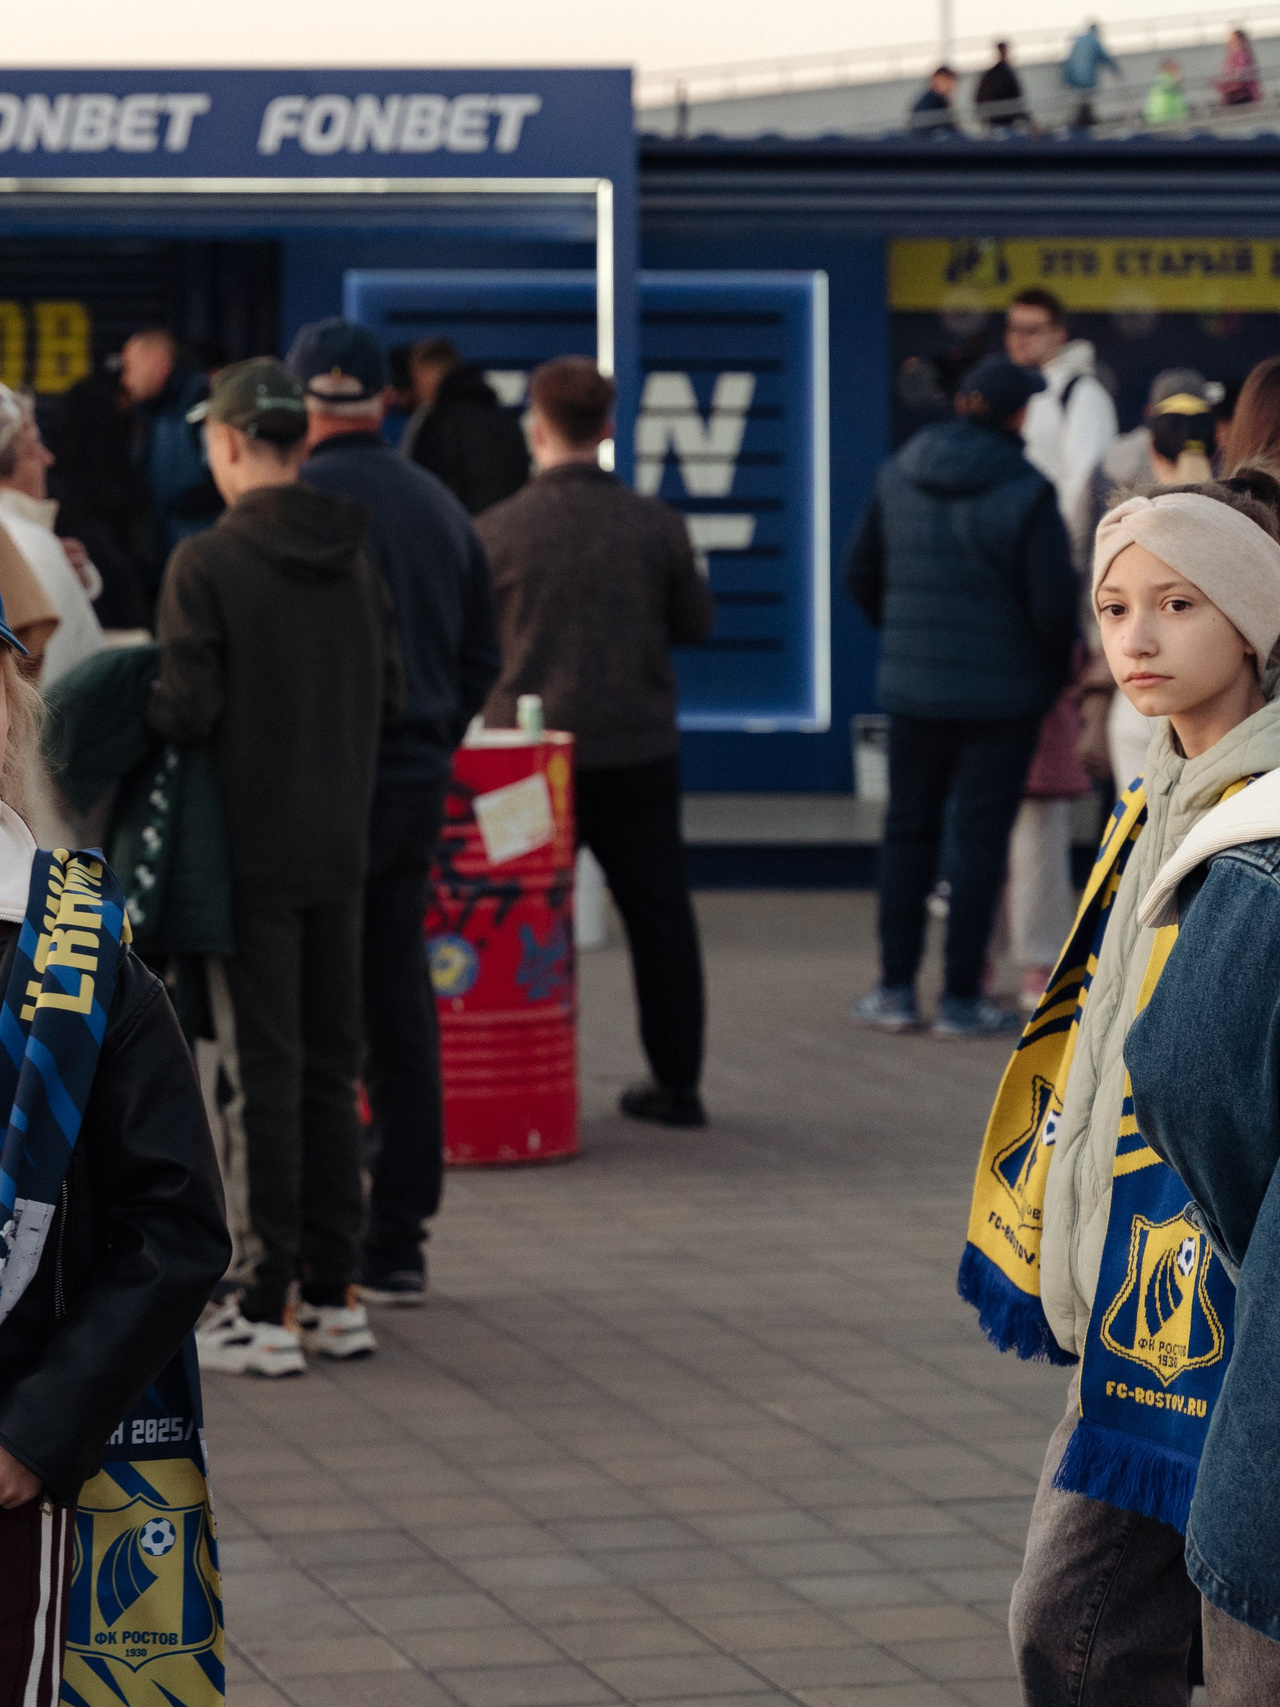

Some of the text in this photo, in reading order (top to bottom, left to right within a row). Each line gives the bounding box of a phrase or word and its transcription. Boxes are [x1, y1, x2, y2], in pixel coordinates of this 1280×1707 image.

[257, 94, 541, 155] FONBET
[1106, 1381, 1207, 1418] FC-ROSTOV.RU
[94, 1631, 178, 1646] ФК РОСТОВ
[125, 1648, 147, 1657] 1930
